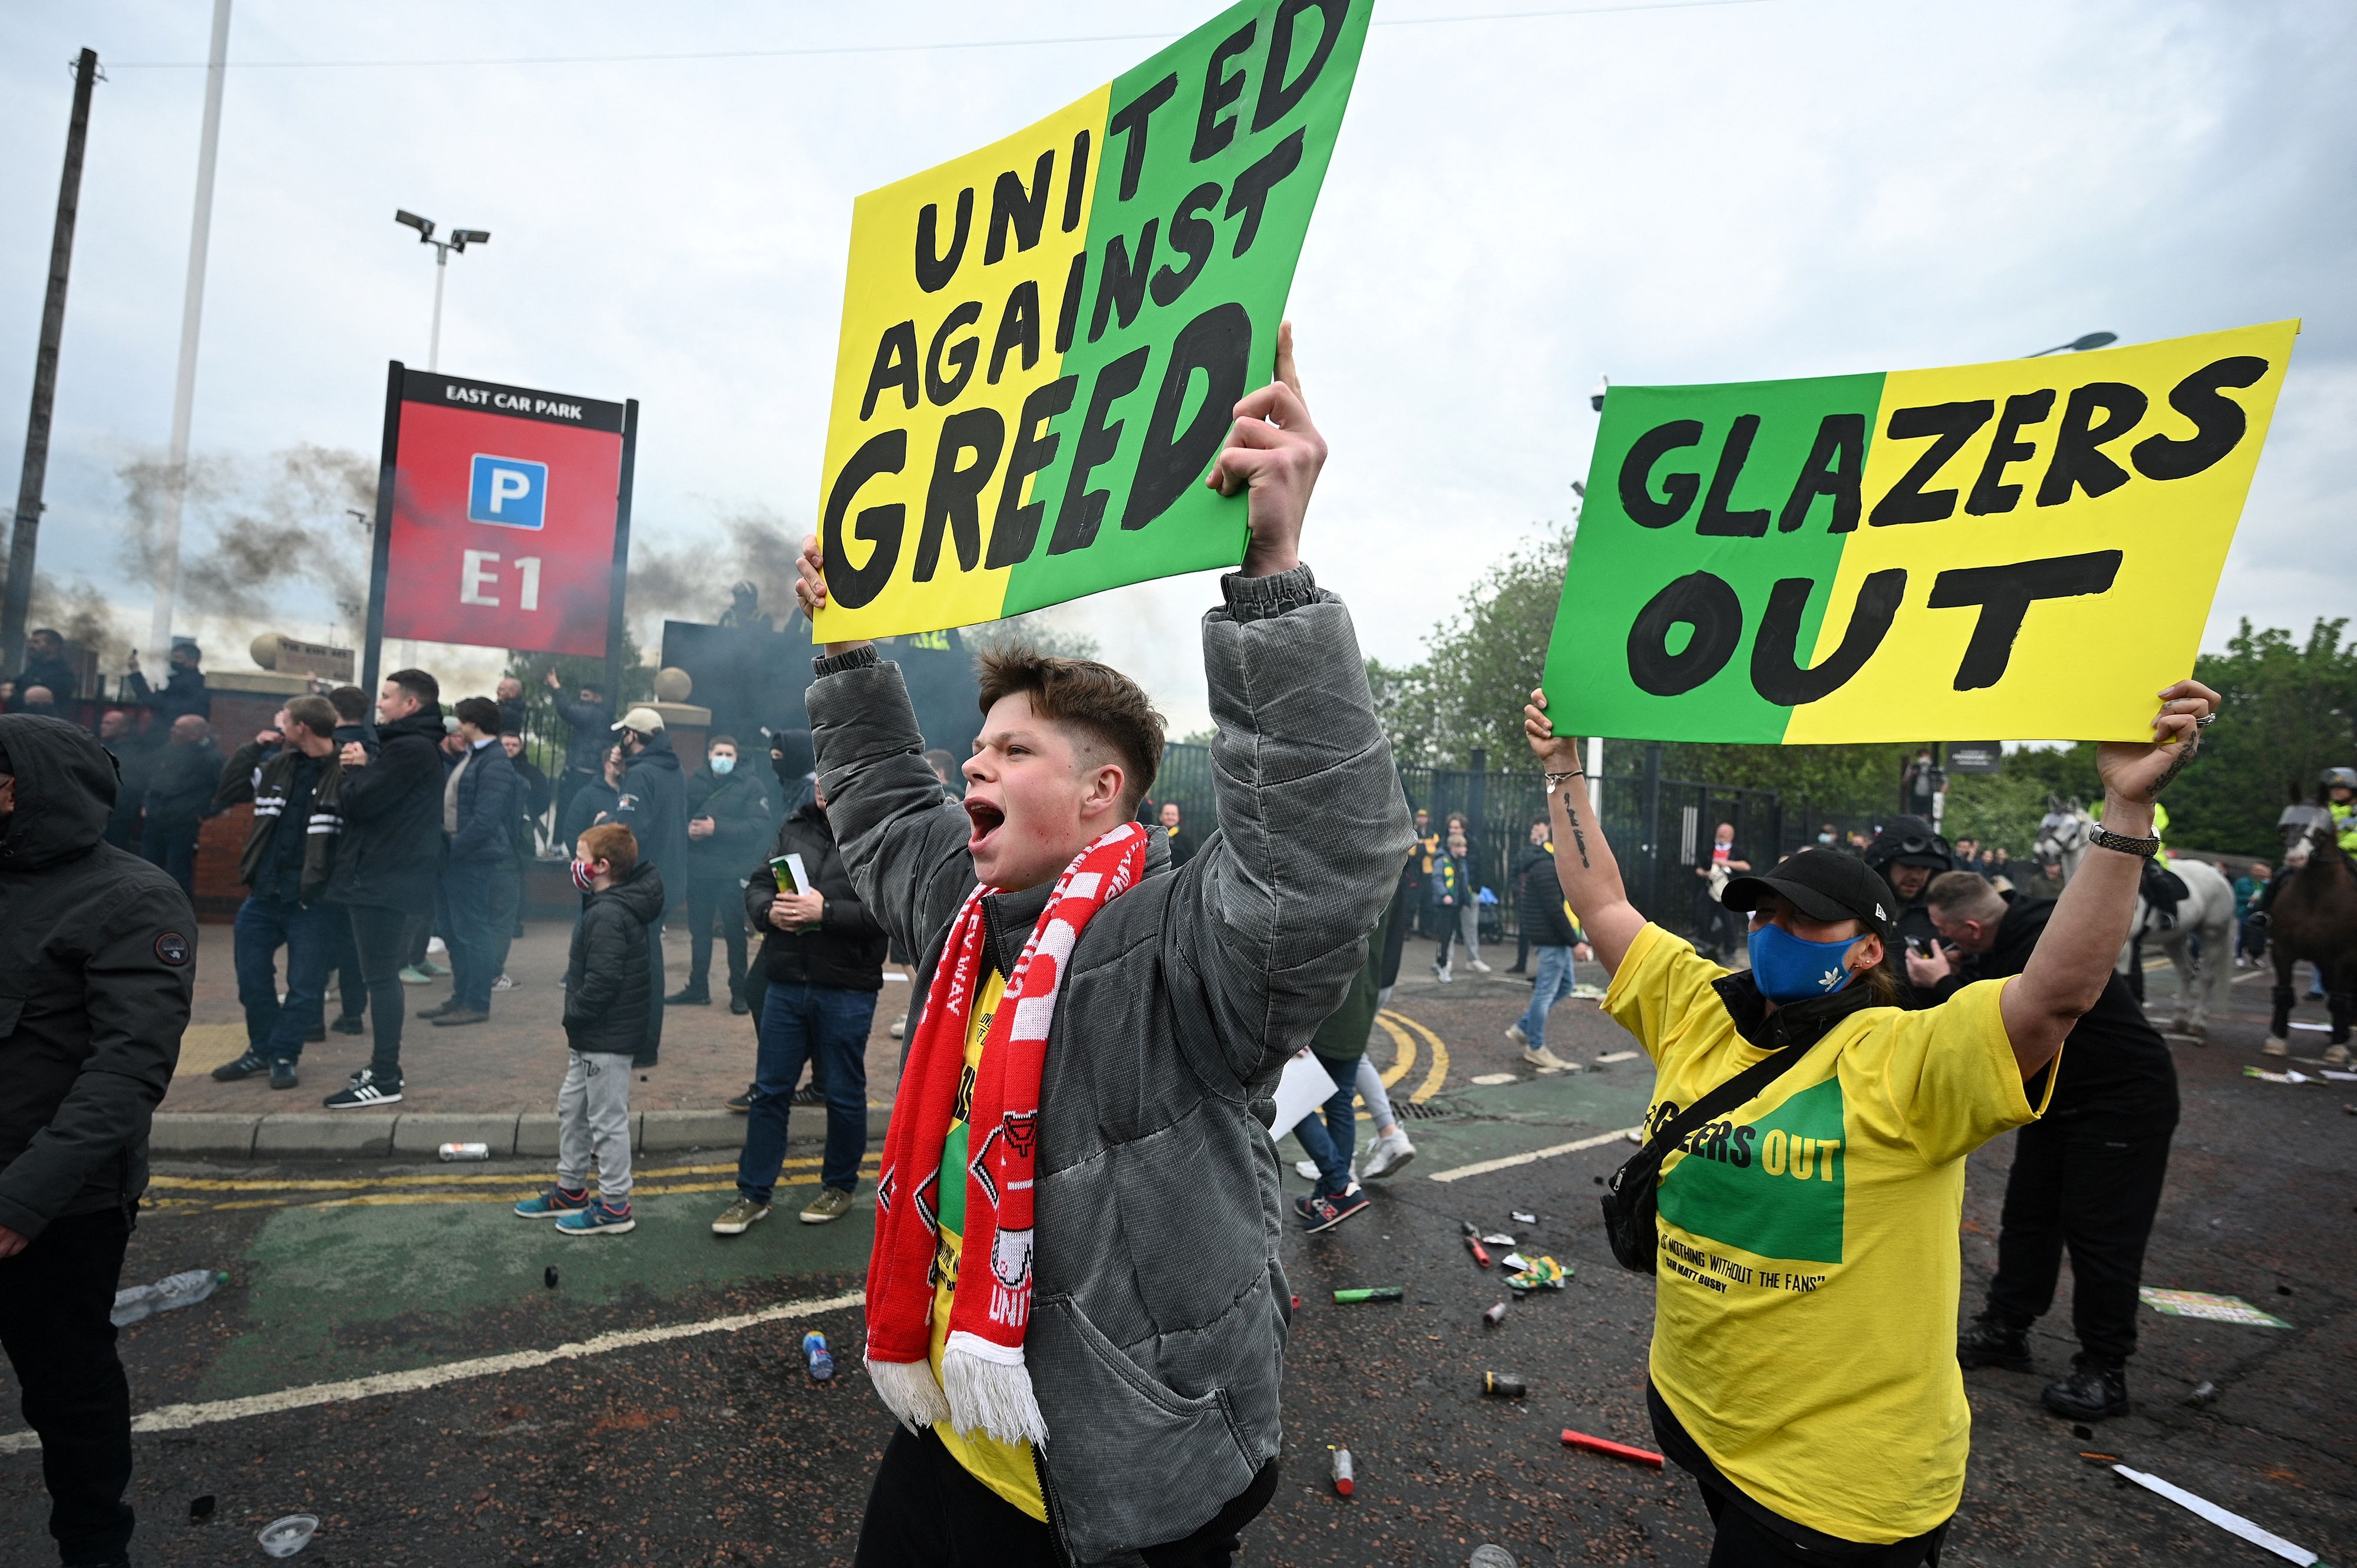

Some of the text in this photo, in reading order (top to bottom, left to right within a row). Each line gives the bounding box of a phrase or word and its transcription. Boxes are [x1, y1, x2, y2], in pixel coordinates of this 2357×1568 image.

[915, 0, 1348, 293] UNITED
[859, 124, 1308, 421] AGAINST
[445, 385, 583, 420] EAST CAR PARK
[824, 302, 1253, 609] GREED
[1618, 355, 2270, 537] GLAZERS
[490, 467, 530, 514] P
[1626, 549, 2123, 707] OUT
[946, 955, 970, 1016] WAY
[1762, 1128, 1840, 1182] OUT
[1661, 1233, 1669, 1250] IS
[1669, 1238, 1705, 1267] NOTHING
[1709, 1254, 1753, 1285] WITHOUT
[1759, 1270, 1780, 1289] THE
[1666, 1256, 1727, 1294] SIR MATT BUSBY
